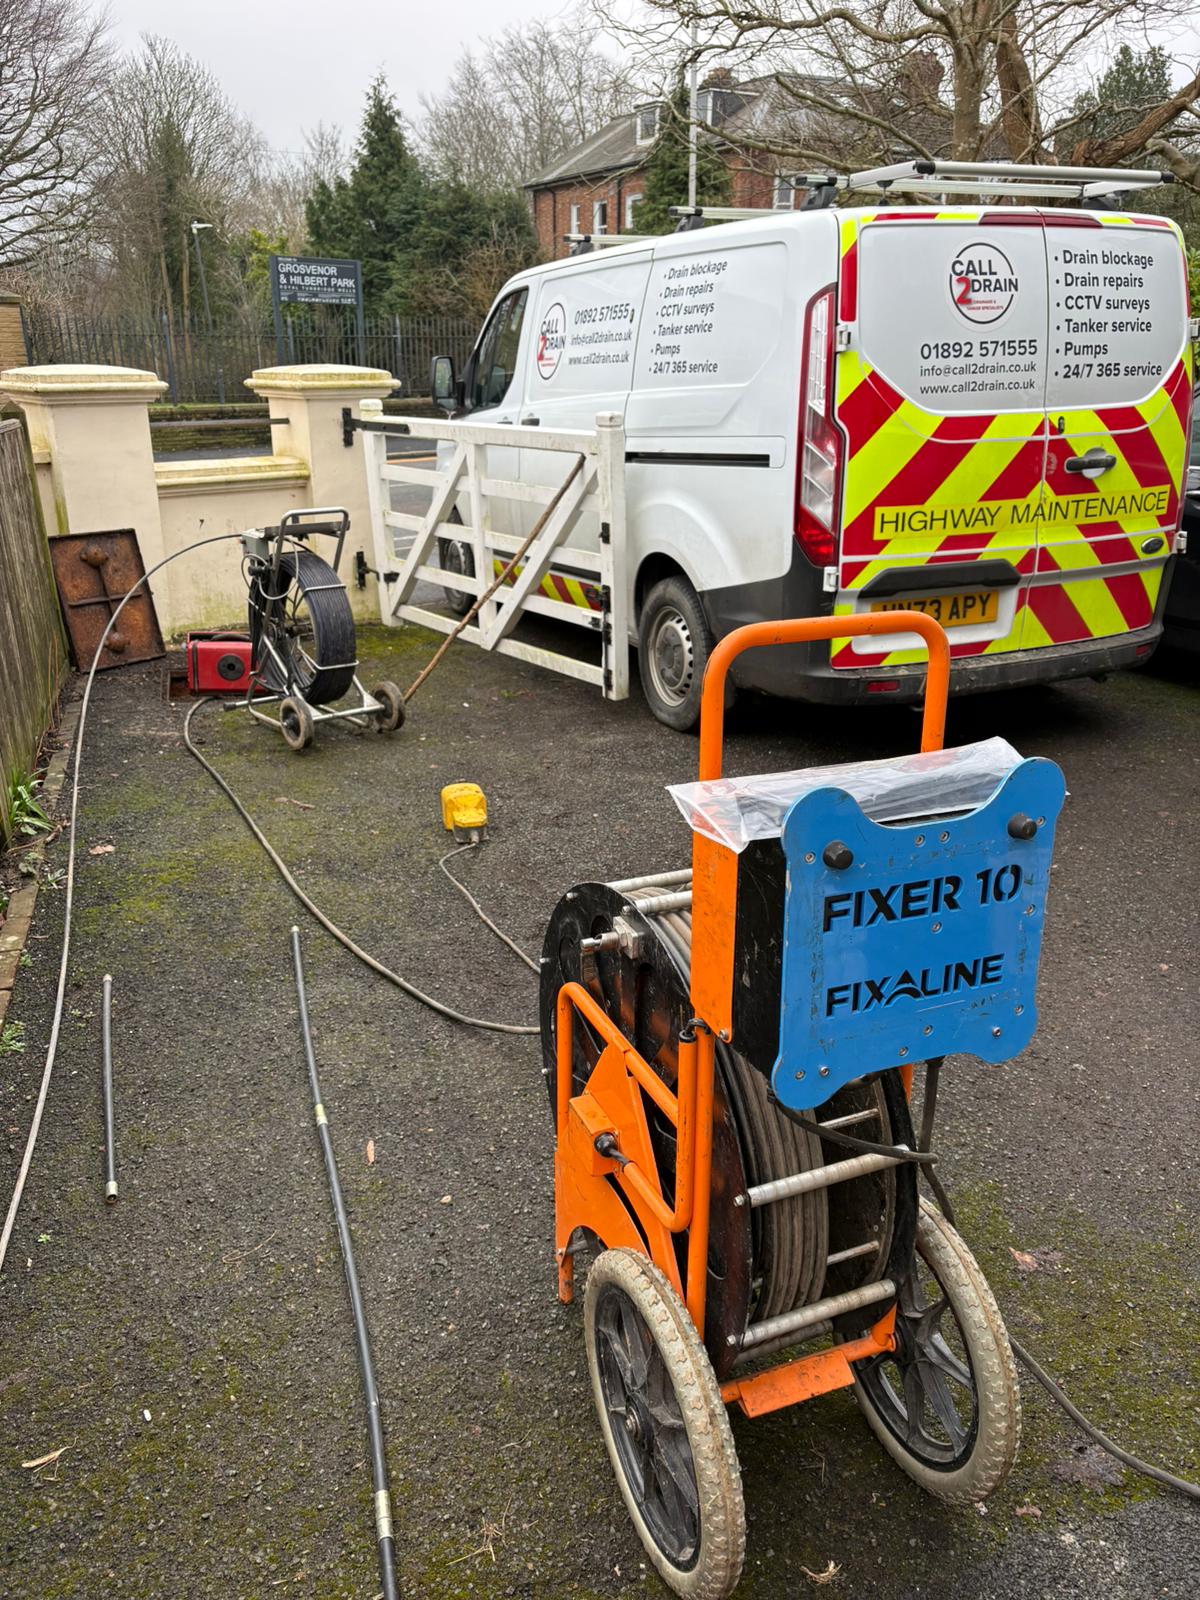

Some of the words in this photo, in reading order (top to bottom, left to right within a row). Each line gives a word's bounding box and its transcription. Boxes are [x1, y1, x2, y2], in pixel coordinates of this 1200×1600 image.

[951, 259, 997, 276] CALL
[1063, 250, 1098, 265] Drain
[1101, 250, 1154, 269] blockage
[278, 263, 337, 276] GROSVENOR
[668, 265, 689, 280] Drain
[689, 260, 728, 277] blockage
[279, 274, 287, 284] &
[290, 276, 328, 286] HILBERT
[331, 278, 355, 288] PARK
[1064, 273, 1100, 287] Drain
[1103, 275, 1144, 291] repairs
[664, 286, 686, 299] Drain
[686, 281, 714, 297] repairs
[660, 304, 682, 317] CCTV
[683, 301, 714, 317] surveys
[1065, 296, 1102, 310] CCTV
[1105, 299, 1150, 313] surveys
[575, 308, 598, 325] 01892
[599, 303, 630, 322] 571555
[540, 318, 559, 335] CALL
[658, 323, 683, 336] Tanker
[684, 321, 713, 335] service
[1065, 318, 1108, 333] Tanker
[1111, 320, 1152, 332] service
[655, 343, 681, 357] Pumps
[920, 342, 973, 359] 01892
[979, 339, 1038, 358] 571555
[1064, 342, 1109, 358] Pumps
[653, 362, 671, 374] 24/7
[671, 361, 687, 373] 365
[688, 361, 718, 373] service
[920, 361, 1037, 378] info@call2drain.co.uk
[1063, 364, 1093, 379] 24/7
[1096, 363, 1121, 378] 365
[1123, 362, 1162, 377] service
[920, 379, 1035, 395] www.call2drain.co.uk
[879, 505, 1001, 534] HIGHWAY
[1010, 491, 1168, 524] MAINTENANCE
[948, 593, 991, 620] APY
[822, 875, 963, 933] FIXER
[976, 864, 1023, 905] 10
[825, 953, 1005, 1017] FIXALINE
